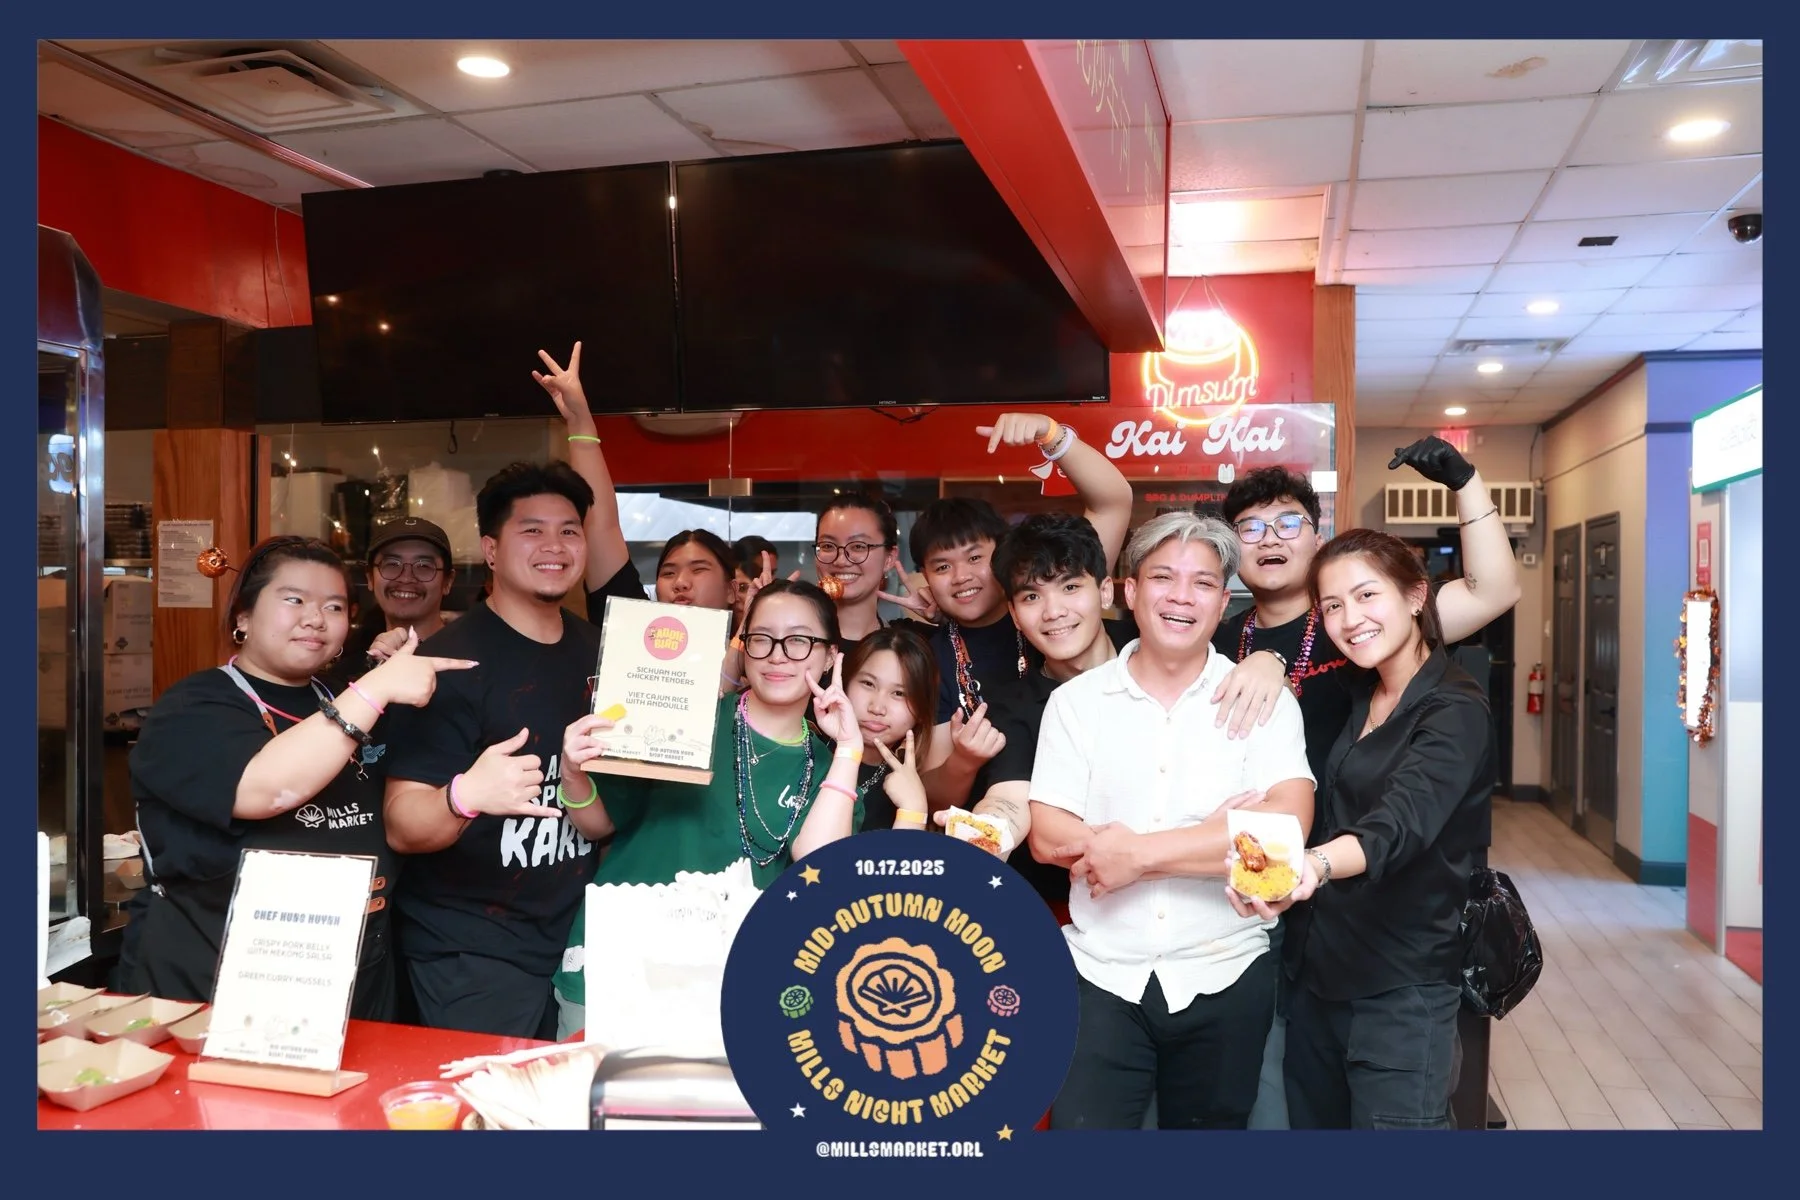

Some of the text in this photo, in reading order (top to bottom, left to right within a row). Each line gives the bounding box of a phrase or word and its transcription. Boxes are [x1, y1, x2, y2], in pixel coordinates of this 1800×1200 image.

[1105, 416, 1286, 459] Kai Kai
[636, 666, 670, 677] SICHUAN
[626, 672, 695, 686] CHICKEN TENDERS
[625, 698, 689, 711] WITH ANDOUILLE
[645, 693, 671, 702] CAJUN
[671, 696, 689, 704] RICE
[326, 802, 359, 818] MILLS
[328, 812, 374, 829] MARKET
[253, 909, 341, 926] CHEF HUNG HUYNH
[252, 938, 330, 952] CRISPY PORK BELLY
[247, 947, 333, 961] WITH MEKONG SALSA
[238, 970, 332, 987] GREEN CURRY MUSSELS
